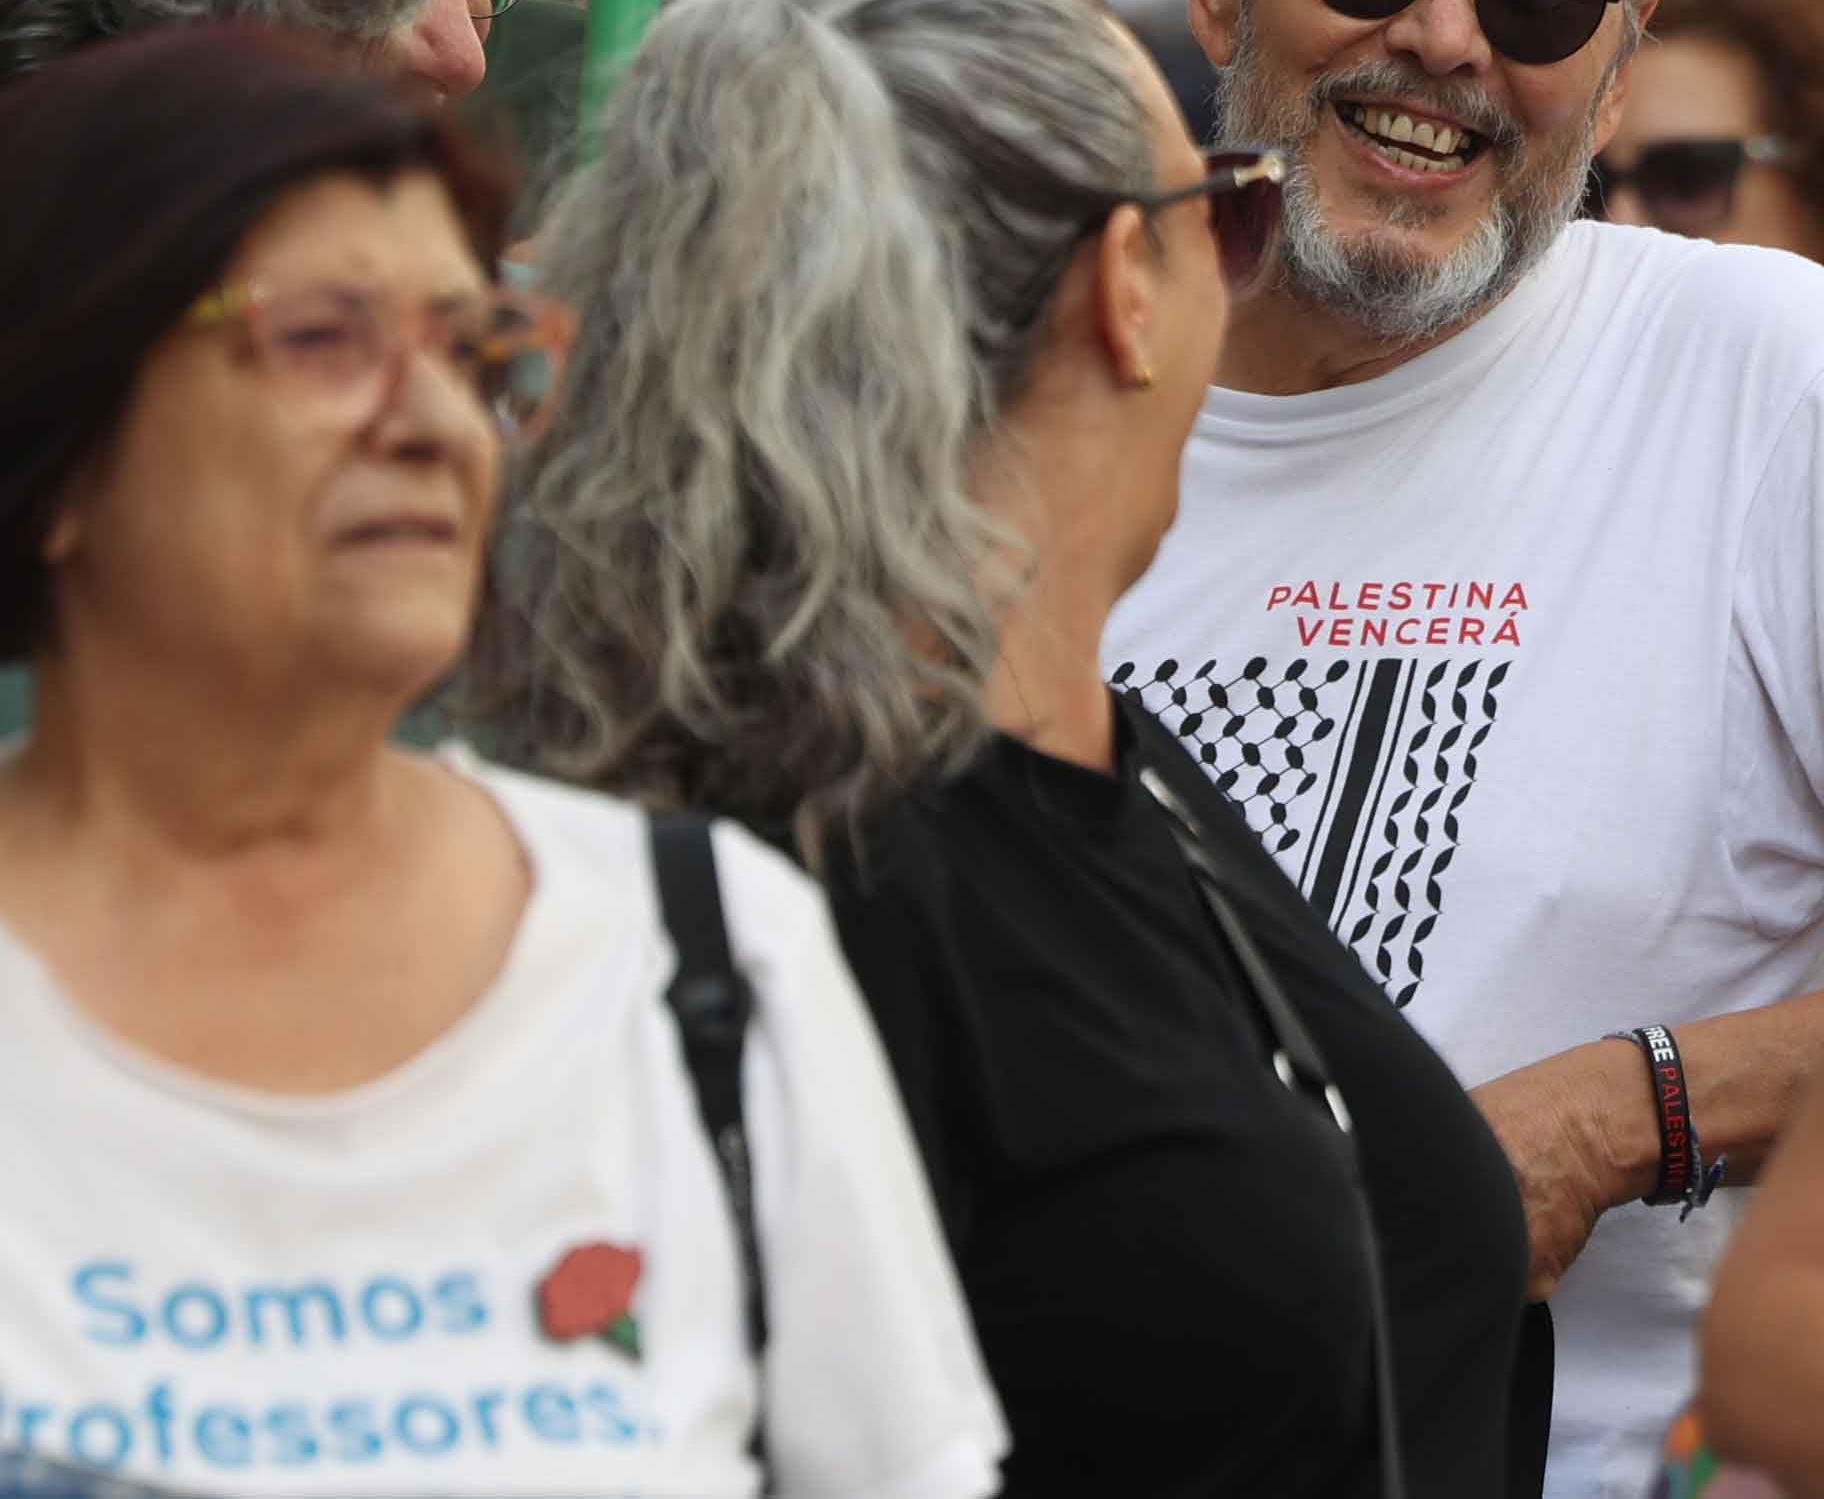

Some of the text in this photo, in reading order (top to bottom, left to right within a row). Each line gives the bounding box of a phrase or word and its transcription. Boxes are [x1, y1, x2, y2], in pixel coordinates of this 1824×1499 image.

[1266, 580, 1529, 612] PALESTINA
[1296, 611, 1521, 647] VENCERÁ
[69, 1256, 490, 1352] Somos
